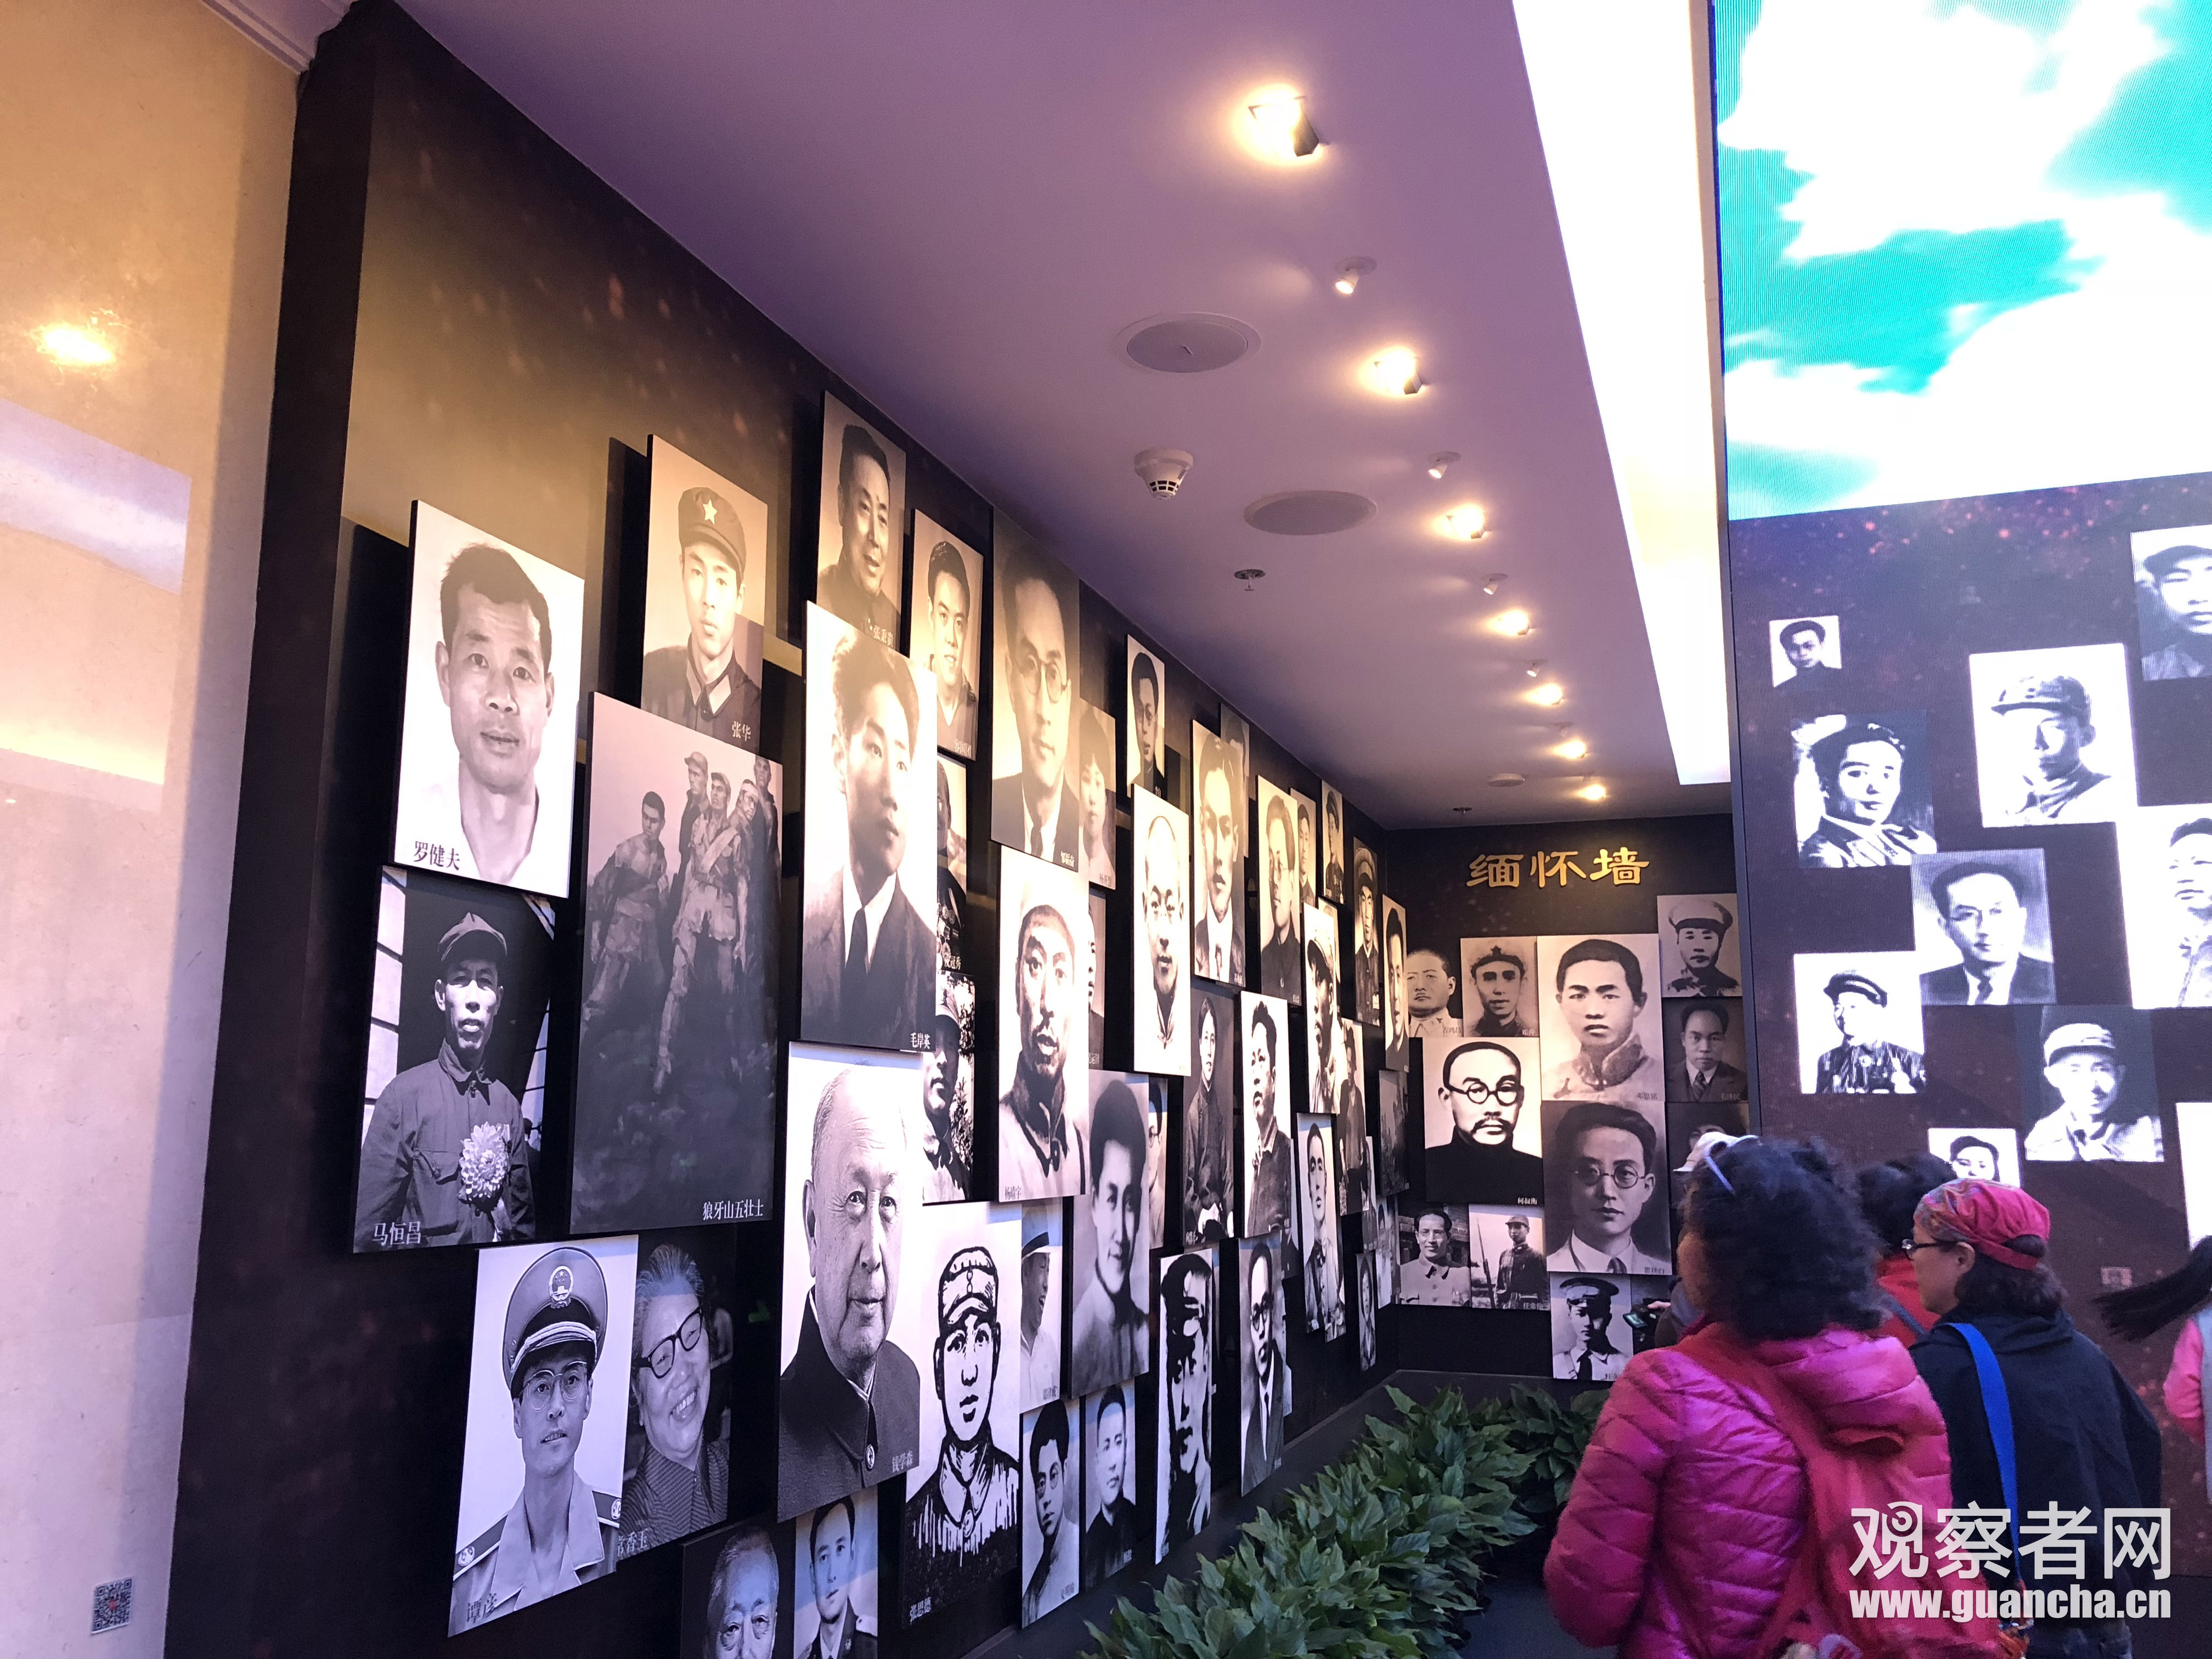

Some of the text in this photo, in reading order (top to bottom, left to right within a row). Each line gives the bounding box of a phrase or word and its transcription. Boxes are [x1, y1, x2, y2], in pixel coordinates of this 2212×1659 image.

[732, 721, 752, 742] 张华
[414, 840, 460, 871] 罗健夫
[1466, 847, 1650, 888] 缅怀墙
[910, 1032, 930, 1049] 毛岸英
[703, 1199, 764, 1220] 狼牙山五壮士
[373, 1221, 421, 1246] 马恒昌
[891, 1451, 913, 1472] 钱学森
[467, 1592, 497, 1624] 谭彦
[910, 1596, 932, 1622] 张思德
